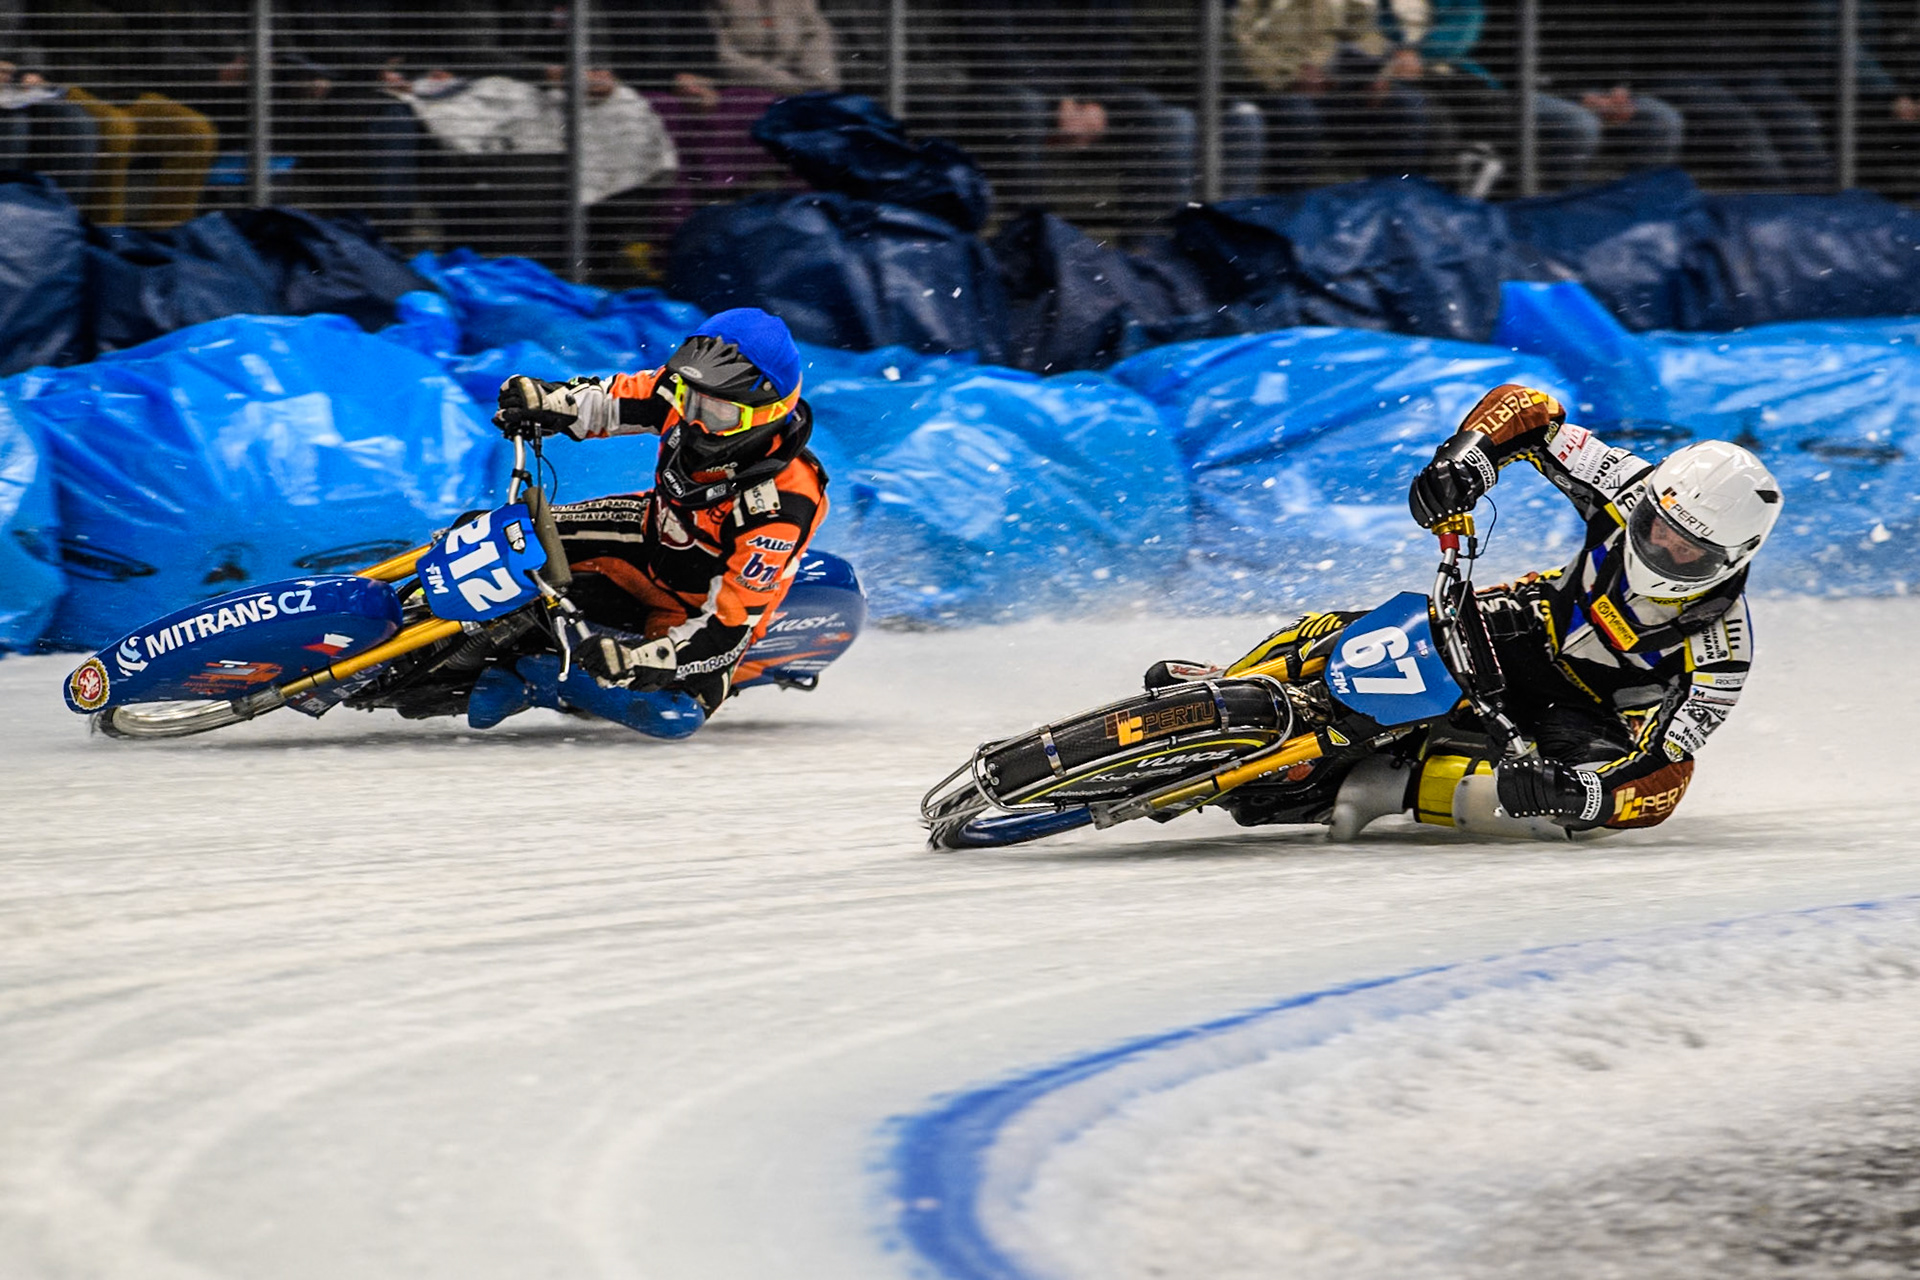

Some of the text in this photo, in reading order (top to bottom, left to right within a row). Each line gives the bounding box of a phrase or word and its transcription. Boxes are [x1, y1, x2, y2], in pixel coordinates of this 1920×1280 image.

[1670, 503, 1714, 538] PERTU
[445, 511, 522, 612] 212
[425, 562, 449, 594] FIM
[1702, 628, 1715, 659] OMAN
[1341, 626, 1426, 695] 67
[1330, 663, 1350, 694] FIM
[1143, 701, 1216, 733] PERTU
